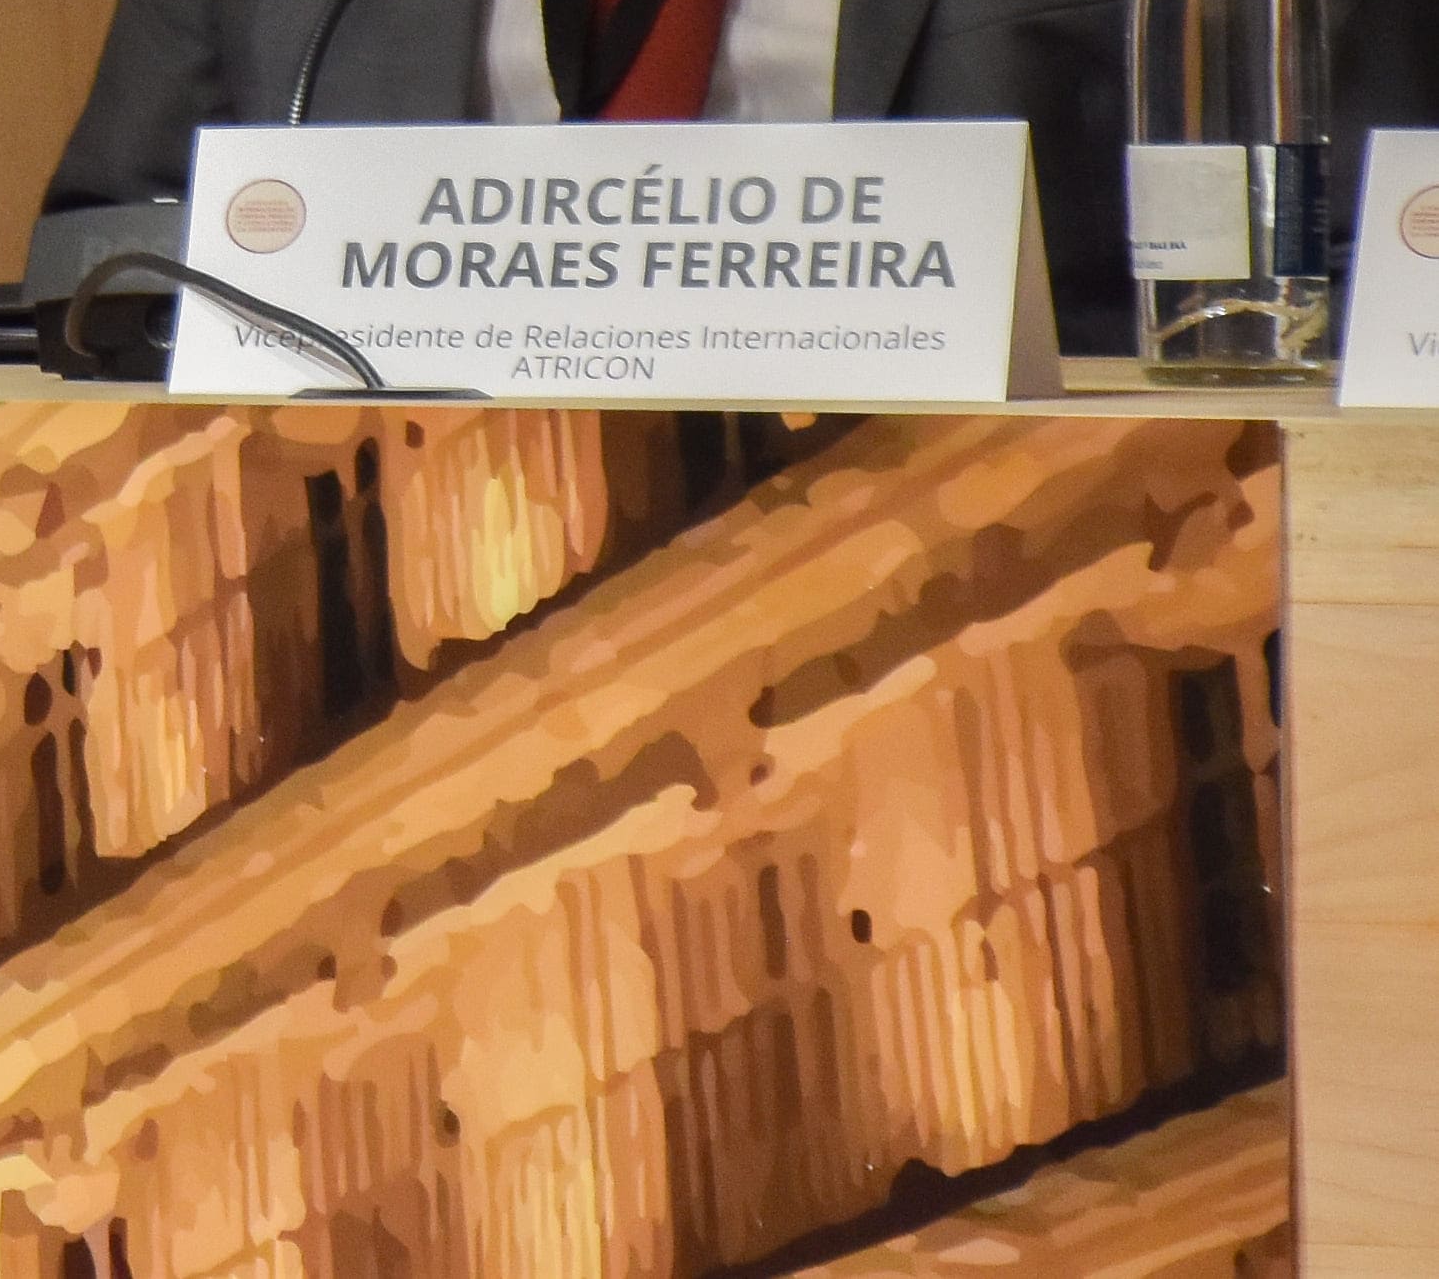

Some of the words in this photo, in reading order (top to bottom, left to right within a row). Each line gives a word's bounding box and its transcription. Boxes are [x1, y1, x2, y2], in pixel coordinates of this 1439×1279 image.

[419, 163, 777, 226] ADIRCÉLIO
[800, 176, 885, 224] DE
[341, 241, 621, 289] MORAES
[642, 240, 956, 288] FERREIRA
[474, 323, 513, 349] de
[524, 324, 692, 350] Relaciones
[702, 324, 947, 351] Internacionales
[511, 355, 656, 381] ATRICON
